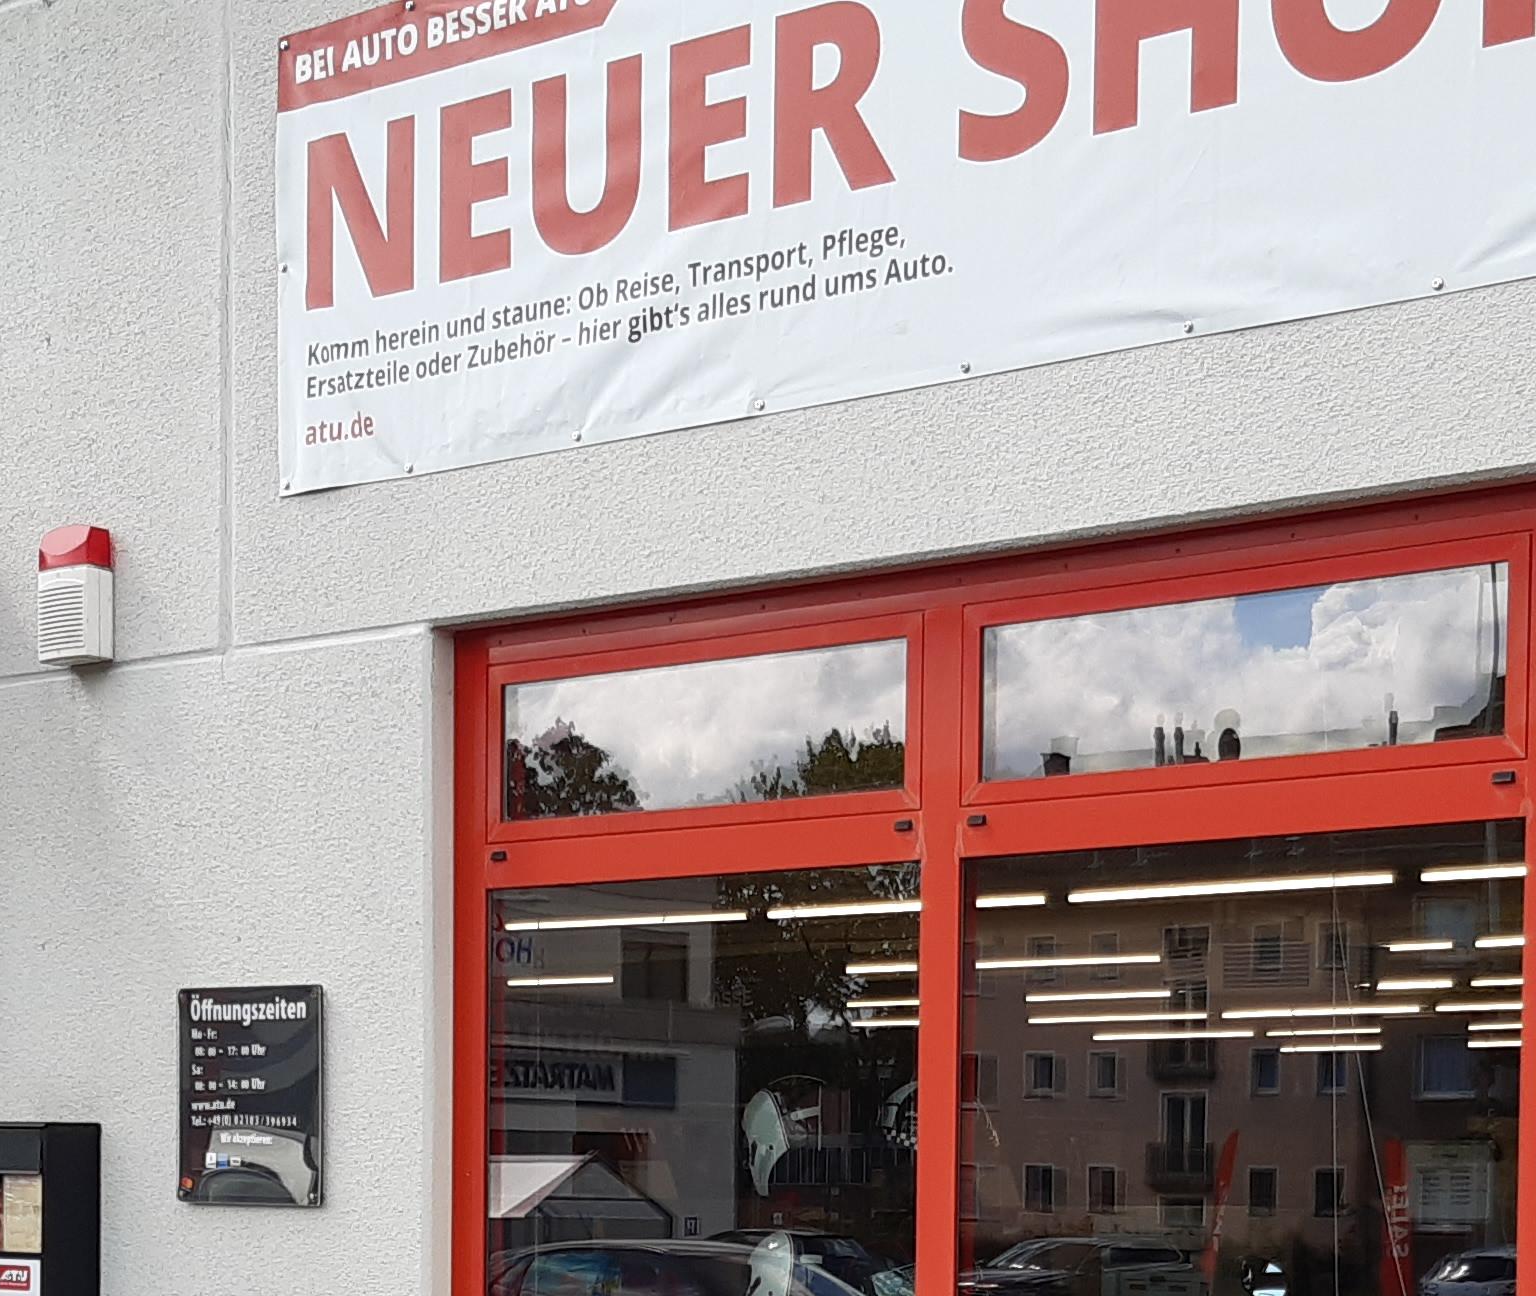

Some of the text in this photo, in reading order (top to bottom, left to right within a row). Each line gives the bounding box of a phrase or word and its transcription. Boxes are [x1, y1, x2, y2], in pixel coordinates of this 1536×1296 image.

[295, 0, 529, 84] BEI AUTO BESSER
[305, 1, 897, 311] NEUER
[305, 363, 411, 399] Ersatzteile
[415, 353, 463, 381] oder
[467, 330, 556, 372] Zubehör
[577, 316, 622, 348] hier
[696, 290, 752, 325] alles
[758, 276, 817, 313] rund
[823, 274, 877, 301] ums
[883, 251, 954, 288] Auto.
[307, 222, 907, 367] Komm herein und staune: Ob Reise, Transport, Pflege,
[304, 411, 375, 447] atu.de
[190, 994, 307, 1027] Öffnungszeiten
